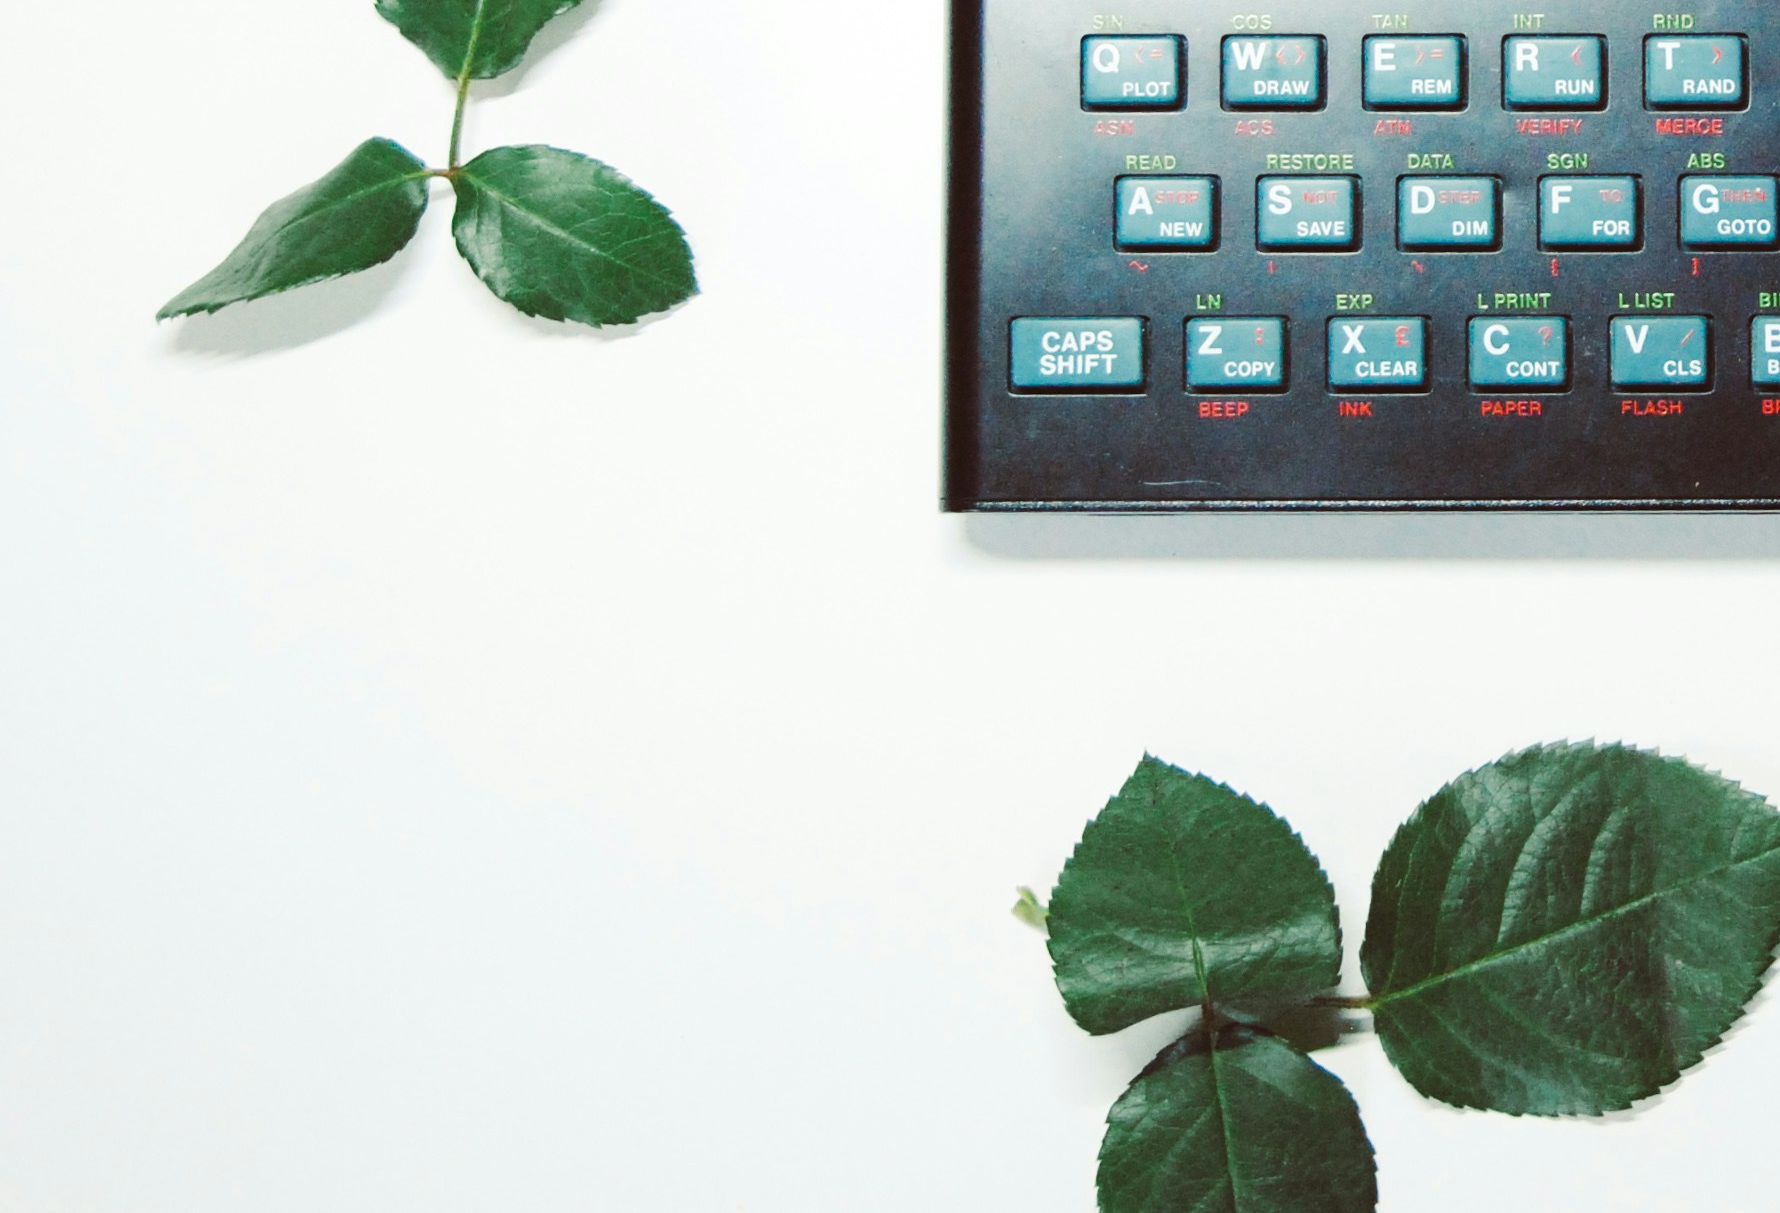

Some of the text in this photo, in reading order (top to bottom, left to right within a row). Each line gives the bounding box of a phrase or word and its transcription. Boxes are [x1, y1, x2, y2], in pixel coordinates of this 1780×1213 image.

[1093, 15, 1123, 30] SIN
[1232, 15, 1272, 30] COS
[1373, 15, 1407, 29] TAN
[1513, 15, 1544, 28] INT
[1653, 14, 1694, 28] RND
[1093, 43, 1120, 72] Q
[1232, 42, 1267, 70] W
[1374, 43, 1396, 71] E
[1516, 43, 1539, 71] R
[1657, 42, 1680, 70] T
[1123, 82, 1170, 96] PLOT
[1254, 81, 1309, 95] DRAW
[1411, 80, 1452, 94] REM
[1555, 80, 1594, 94] RUN
[1683, 79, 1735, 94] RAND
[1094, 120, 1134, 135] ASN
[1235, 120, 1274, 135] ACS
[1374, 120, 1412, 135] ATN
[1516, 119, 1582, 134] VERIFY
[1656, 119, 1723, 134] MERGE
[1126, 155, 1176, 169] READ
[1267, 155, 1353, 169] RESTORE
[1408, 154, 1454, 168] DATA
[1547, 154, 1588, 168] SGN
[1687, 154, 1725, 168] ABS
[1129, 187, 1153, 215] A
[1155, 192, 1199, 204] STOP
[1268, 186, 1292, 215] S
[1301, 191, 1338, 204] NOT
[1411, 186, 1435, 214] D
[1438, 191, 1482, 203] STEP
[1551, 186, 1572, 213] F
[1600, 190, 1622, 202] TO
[1692, 185, 1719, 214] G
[1722, 189, 1766, 202] THEN
[1160, 222, 1203, 237] NEW
[1297, 221, 1345, 236] SAVE
[1452, 221, 1488, 235] DIM
[1593, 220, 1630, 235] FOR
[1717, 219, 1771, 234] GOTO
[1196, 295, 1222, 309] LN
[1336, 294, 1373, 309] EXP
[1495, 293, 1551, 308] PRINT
[1634, 293, 1674, 308] LIST
[1042, 331, 1113, 352] CAPS
[1198, 326, 1222, 354] Z
[1342, 326, 1365, 354] X
[1484, 325, 1509, 355] C
[1625, 325, 1649, 353] V
[1040, 354, 1117, 375] SHIFT
[1224, 362, 1274, 377] COPY
[1355, 361, 1417, 377] CLEAR
[1506, 361, 1559, 376] CONT
[1663, 360, 1701, 376] CLS
[1199, 403, 1249, 417] BEEP
[1339, 402, 1373, 416] INK
[1481, 401, 1541, 416] PAPER
[1621, 400, 1683, 415] FLASH
